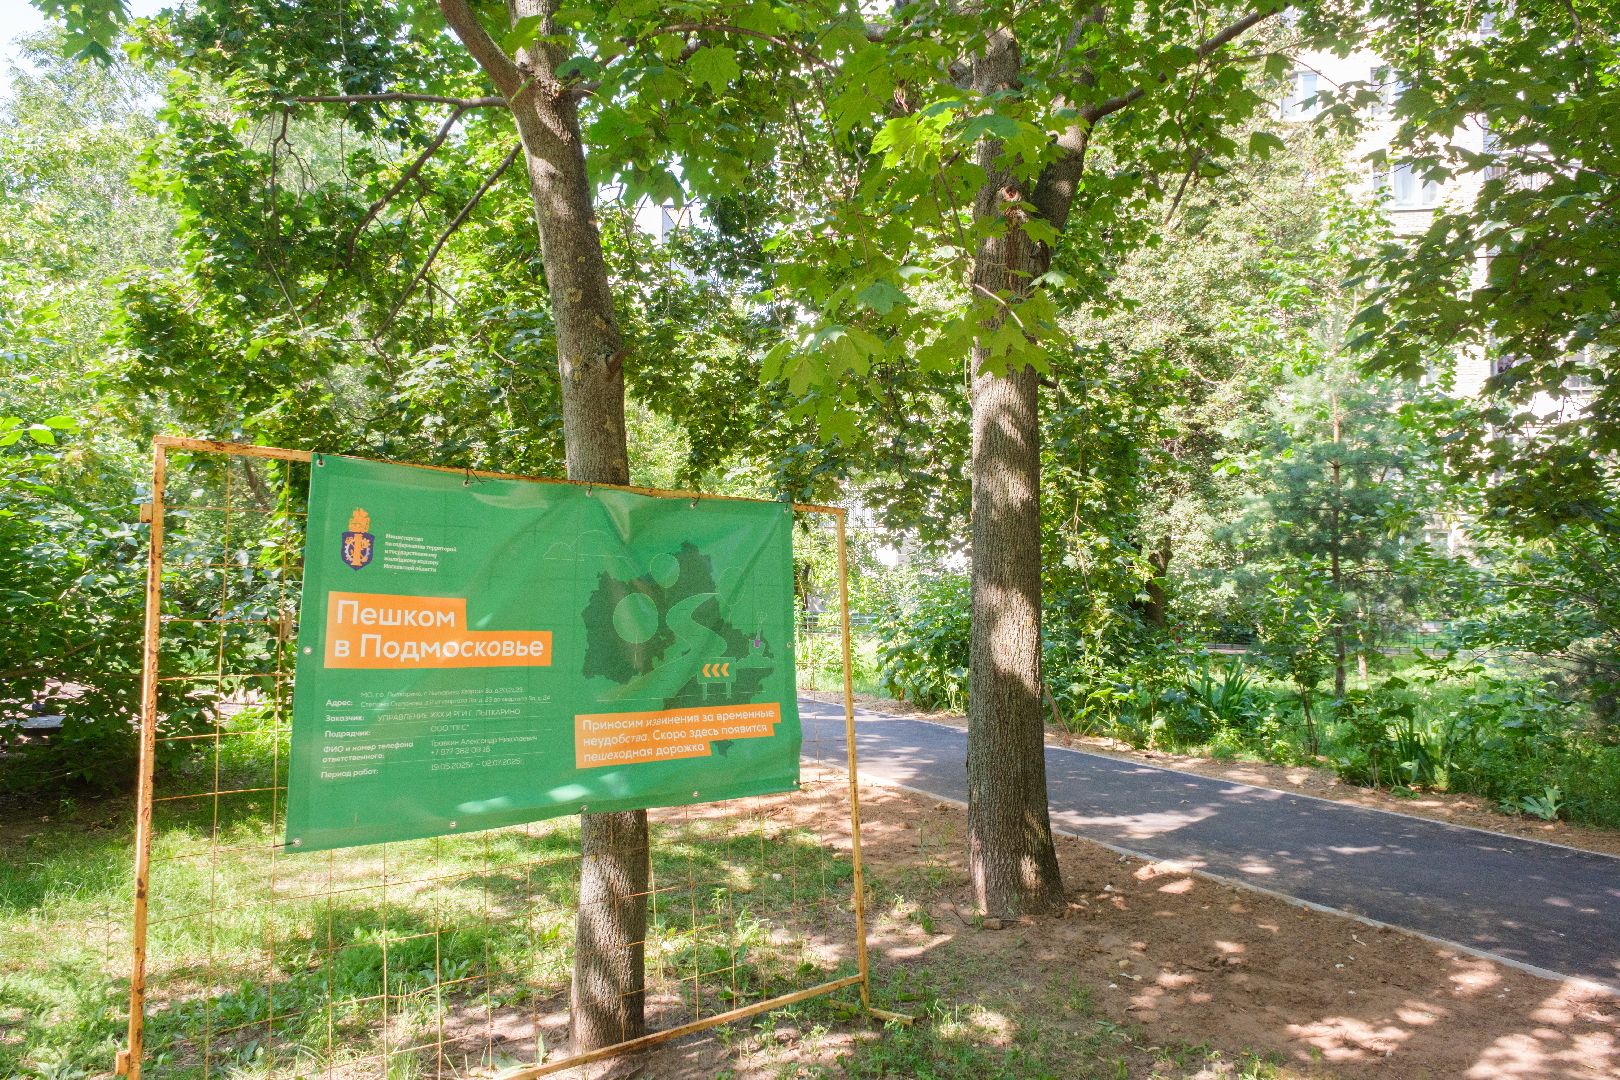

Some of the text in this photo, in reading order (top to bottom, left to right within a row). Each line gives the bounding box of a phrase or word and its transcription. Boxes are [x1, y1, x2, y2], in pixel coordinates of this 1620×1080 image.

[337, 600, 455, 628] Пешком
[335, 634, 544, 662] в Подмосковье
[582, 709, 775, 732] Приносим извинения за временные
[378, 742, 414, 750] телефона
[583, 724, 767, 750] неудобства. Скоро здесь появится
[322, 755, 384, 763] ответственного:
[584, 742, 704, 762] пешеходная дорожка
[321, 768, 379, 779] Период работ:
